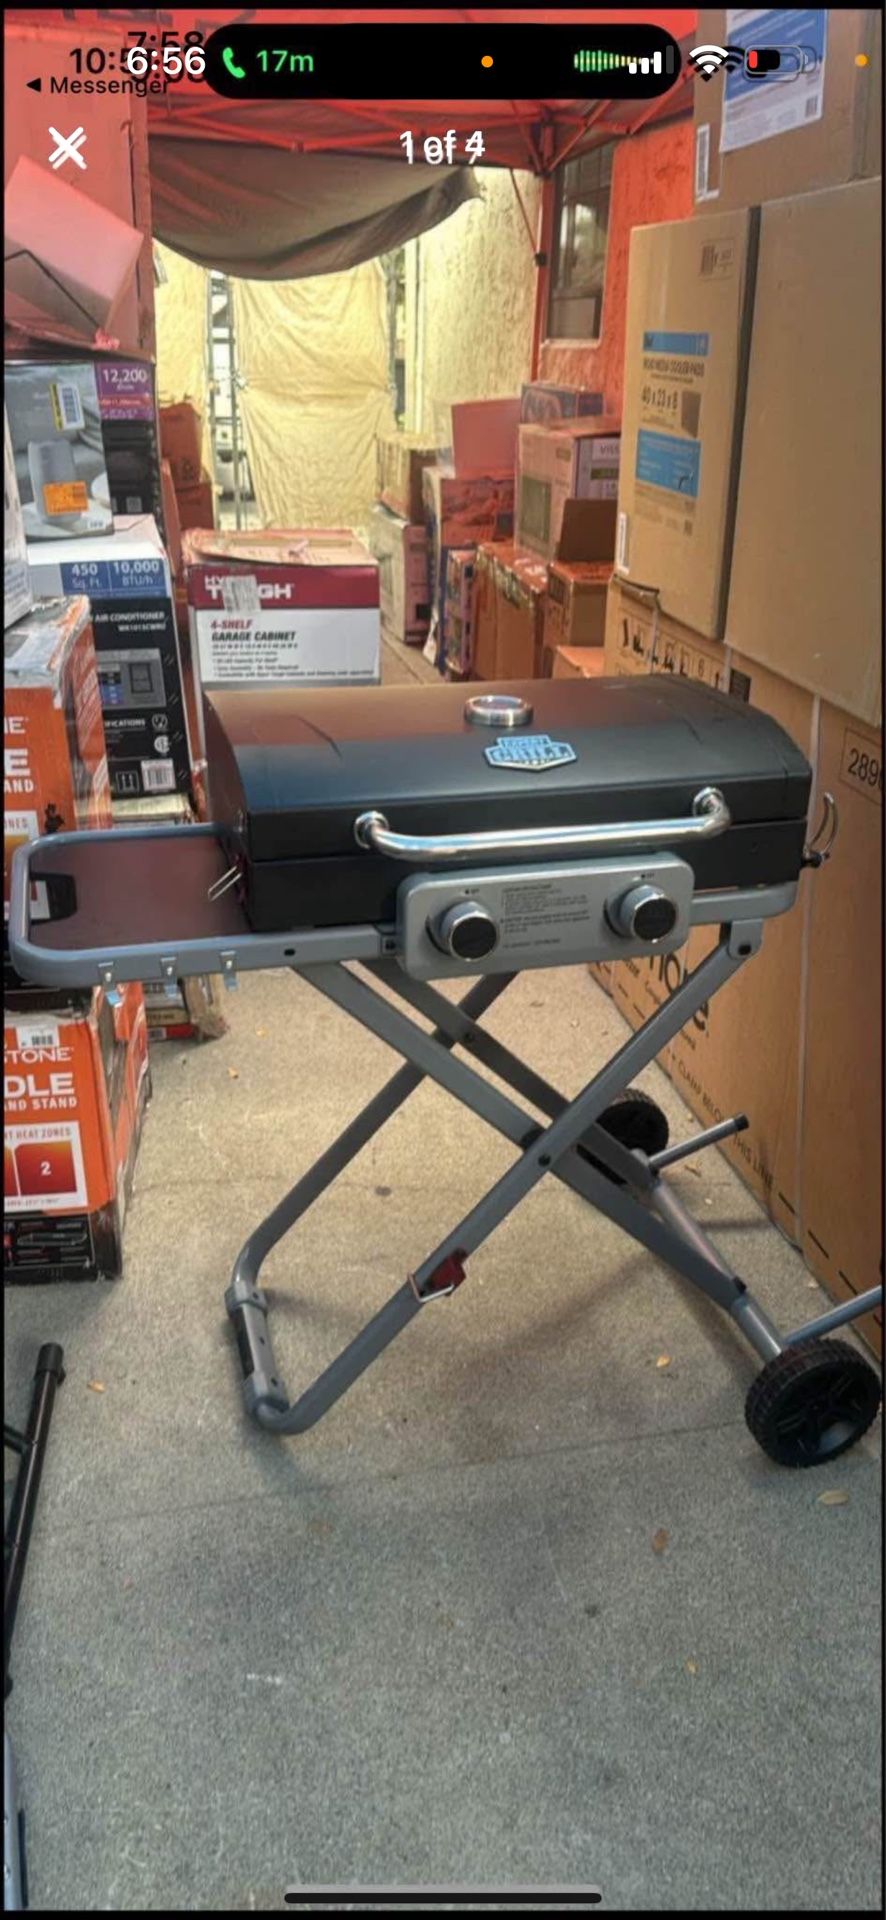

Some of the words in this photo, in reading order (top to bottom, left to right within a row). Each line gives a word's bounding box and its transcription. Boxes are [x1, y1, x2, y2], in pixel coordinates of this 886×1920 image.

[103, 368, 148, 384] 12,200
[72, 563, 98, 577] 450
[113, 561, 159, 576] 10,000
[122, 574, 154, 586] BTU/h
[205, 584, 292, 600] TGH
[95, 613, 109, 623] AIR
[110, 611, 165, 622] CONDITIONER
[211, 619, 252, 630] 4-SHELF
[212, 632, 251, 642] GARAGE
[254, 631, 296, 641] CABINET
[848, 748, 881, 788] 289
[32, 1096, 77, 1110] STAND
[16, 1129, 39, 1139] HEAT
[42, 1126, 71, 1137] ZONES
[41, 1161, 51, 1176] 2
